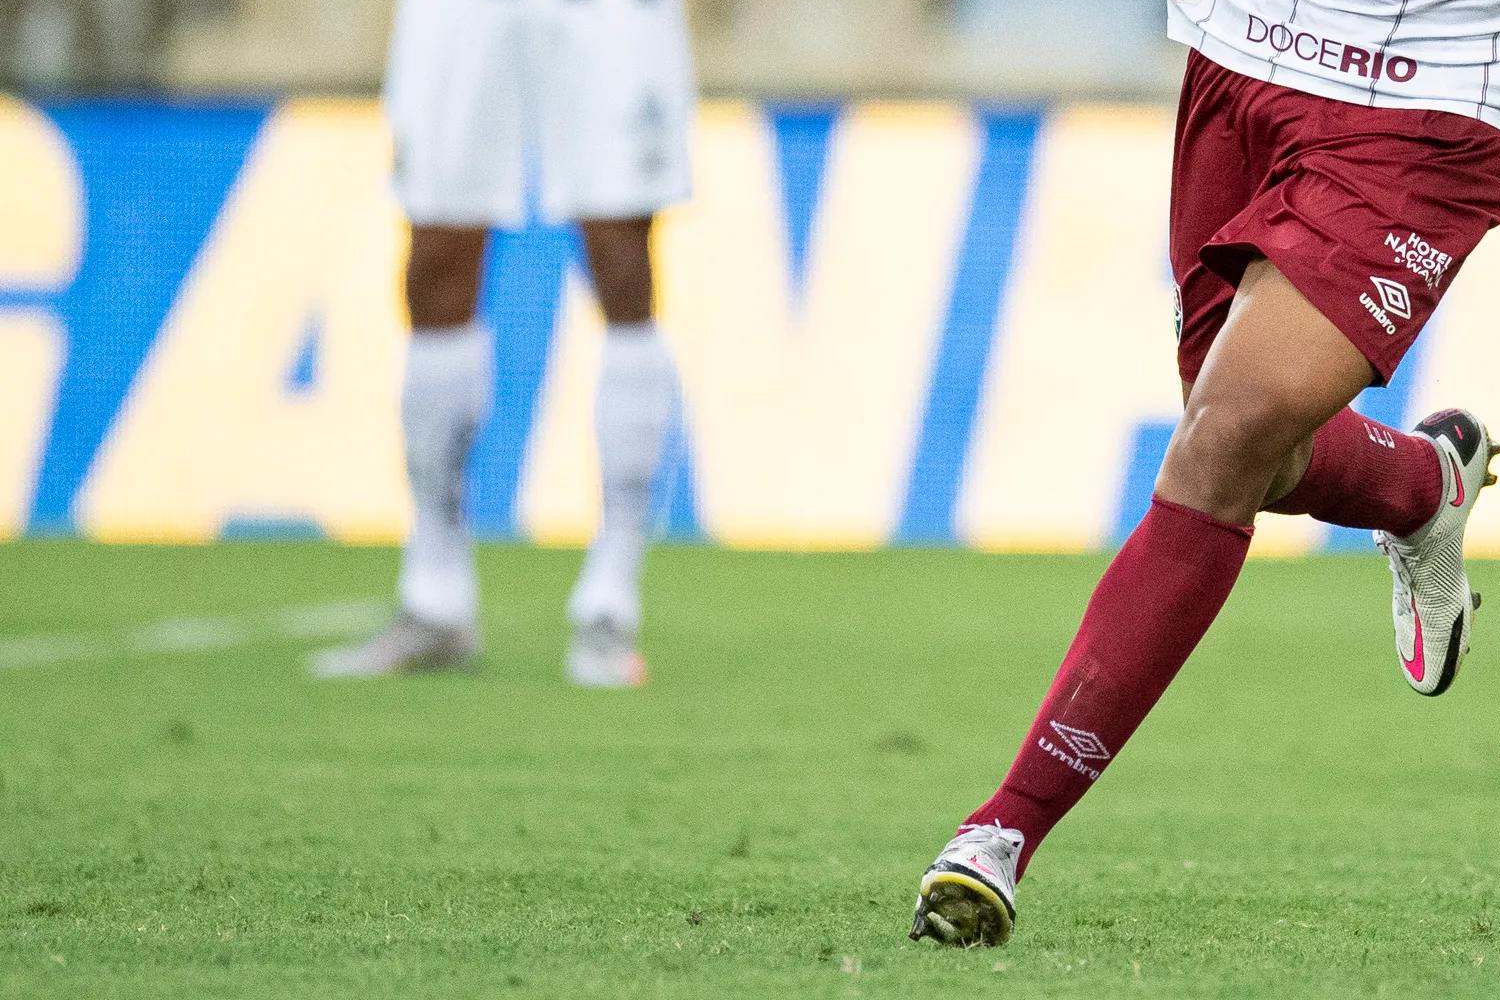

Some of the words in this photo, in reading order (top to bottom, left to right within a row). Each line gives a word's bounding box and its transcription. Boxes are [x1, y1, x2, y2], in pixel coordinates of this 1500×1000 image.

[1246, 14, 1418, 83] DOCERIO
[1407, 232, 1453, 270] HOTEL
[1359, 292, 1396, 335] umbro
[1038, 737, 1100, 780] umbro
